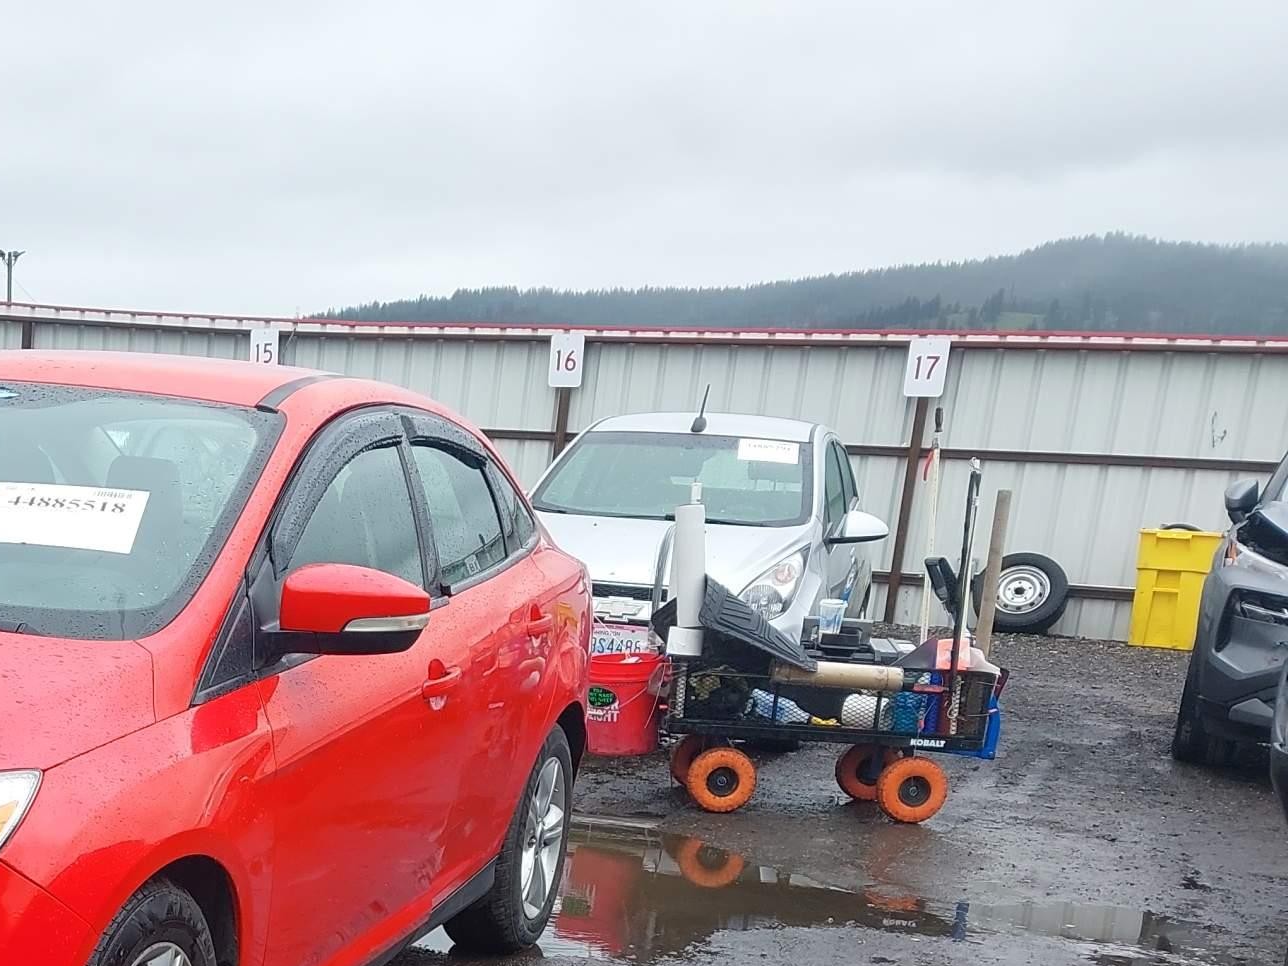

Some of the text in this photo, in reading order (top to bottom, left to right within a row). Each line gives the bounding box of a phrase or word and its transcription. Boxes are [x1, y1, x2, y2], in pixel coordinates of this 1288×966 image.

[255, 343, 273, 364] 15
[556, 349, 577, 372] 16
[914, 355, 941, 380] 17
[8, 495, 126, 513] 44885518
[909, 738, 946, 748] KOBALT
